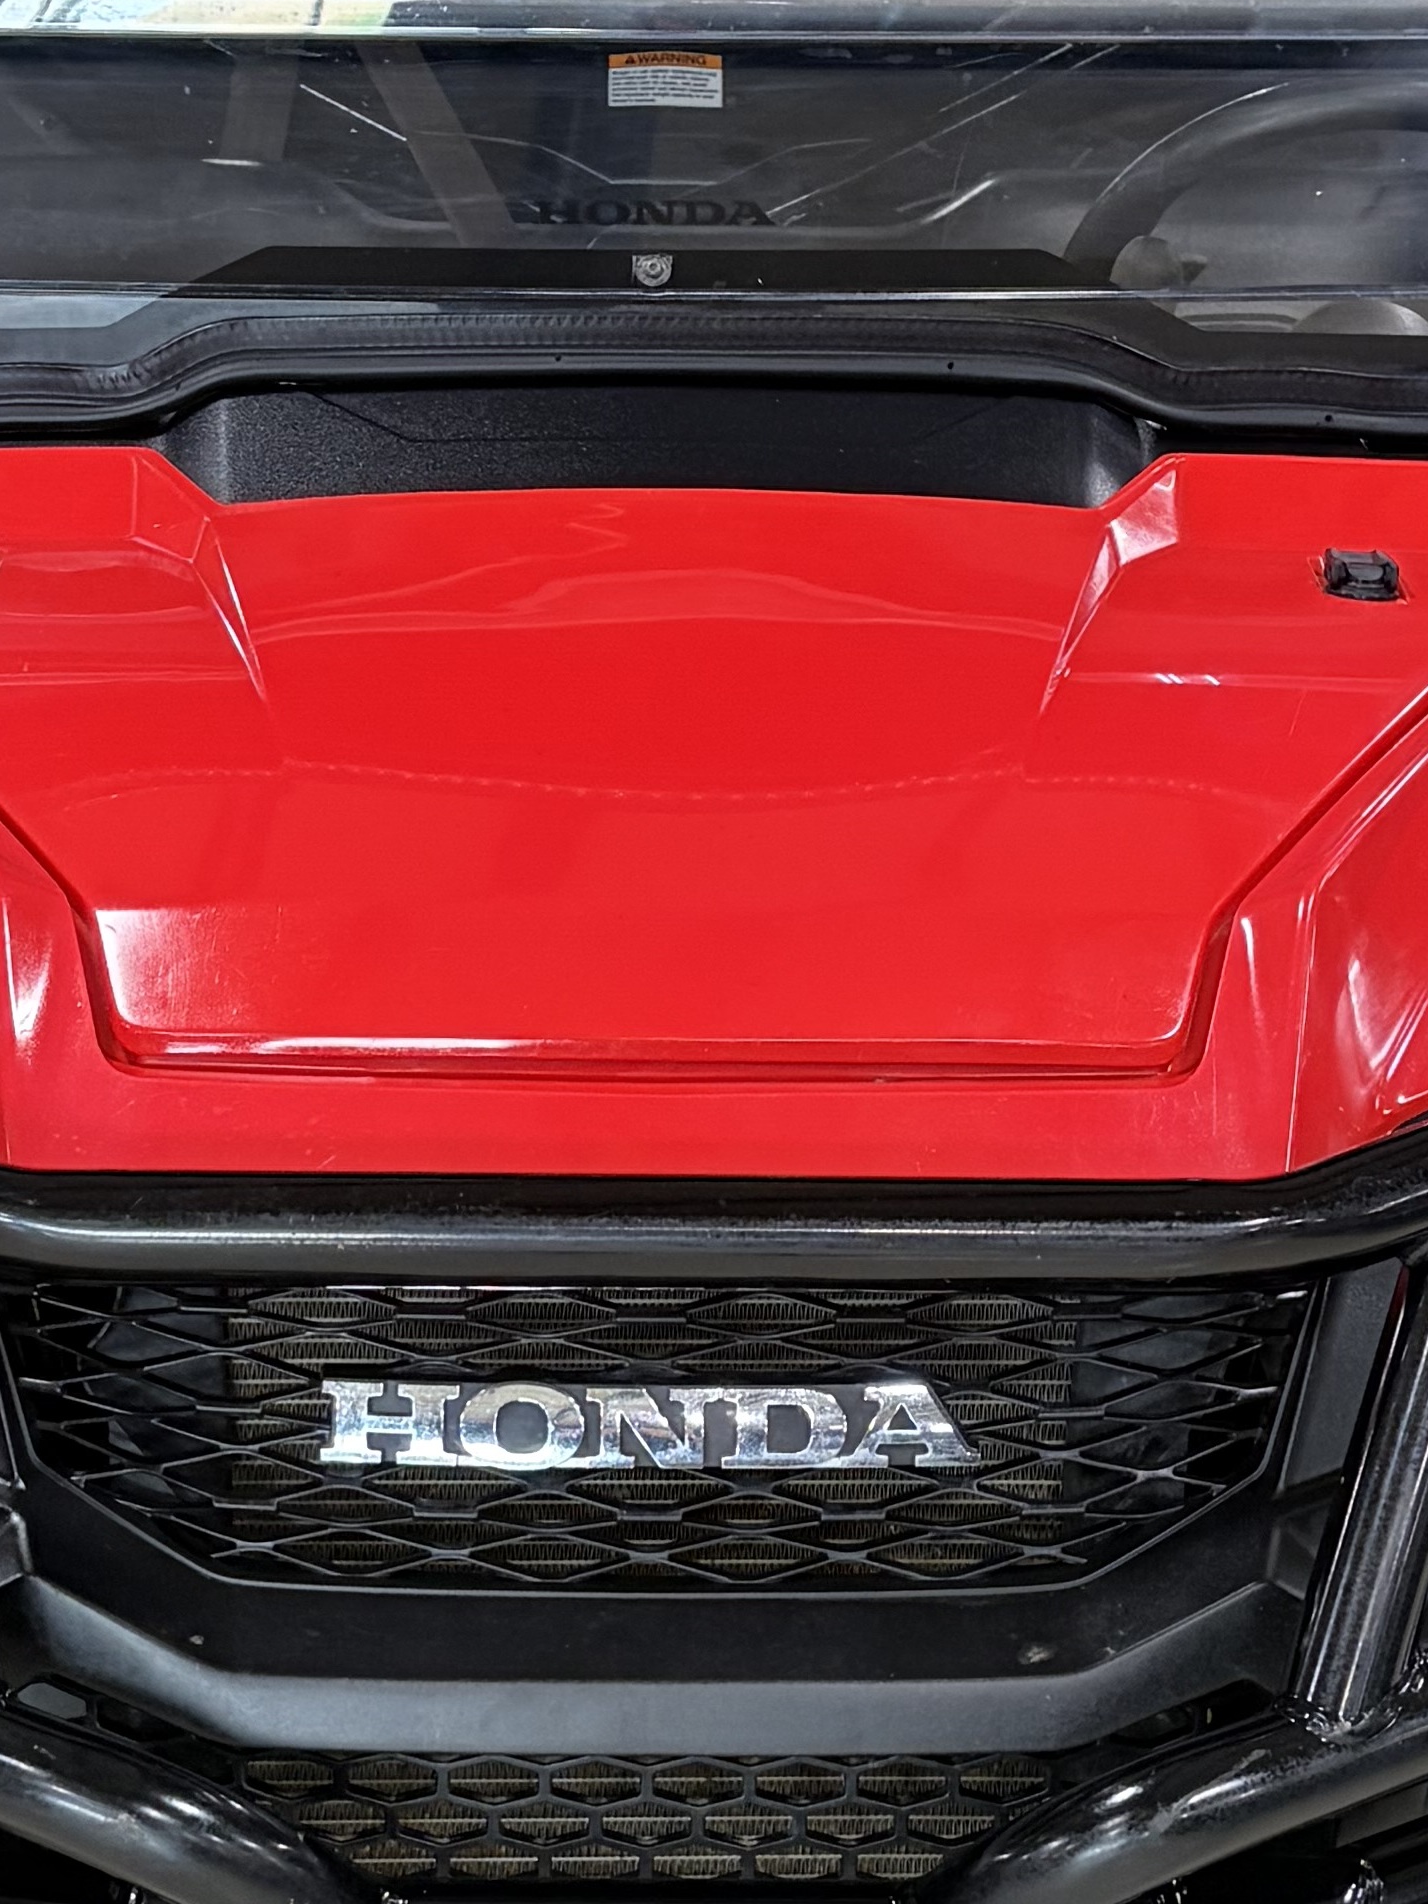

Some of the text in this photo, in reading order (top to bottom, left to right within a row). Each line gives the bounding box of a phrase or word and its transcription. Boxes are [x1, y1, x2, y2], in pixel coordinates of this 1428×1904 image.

[637, 53, 707, 66] WARNING
[533, 198, 776, 226] HONDA
[319, 1378, 981, 1471] HONDA
